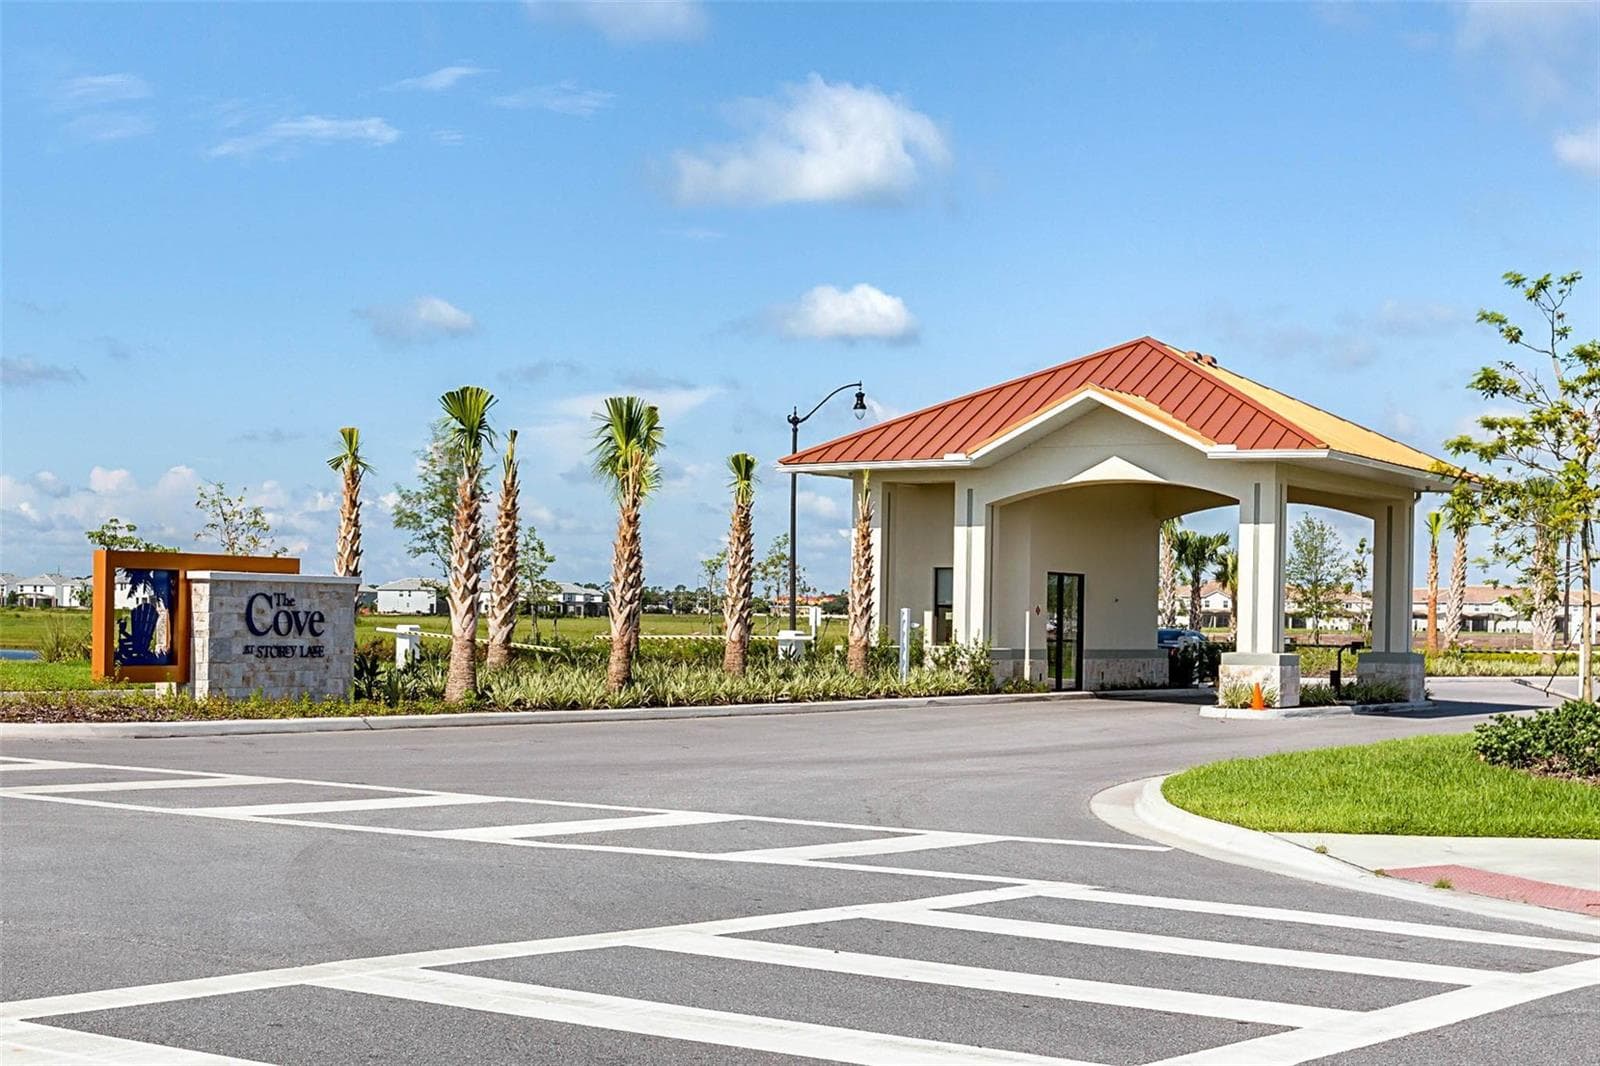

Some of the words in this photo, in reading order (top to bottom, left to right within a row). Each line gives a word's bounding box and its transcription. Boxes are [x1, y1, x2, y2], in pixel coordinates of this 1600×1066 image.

[273, 592, 296, 607] The
[245, 592, 325, 637] Cove
[255, 645, 297, 659] STOREY
[299, 645, 325, 659] LAKE
